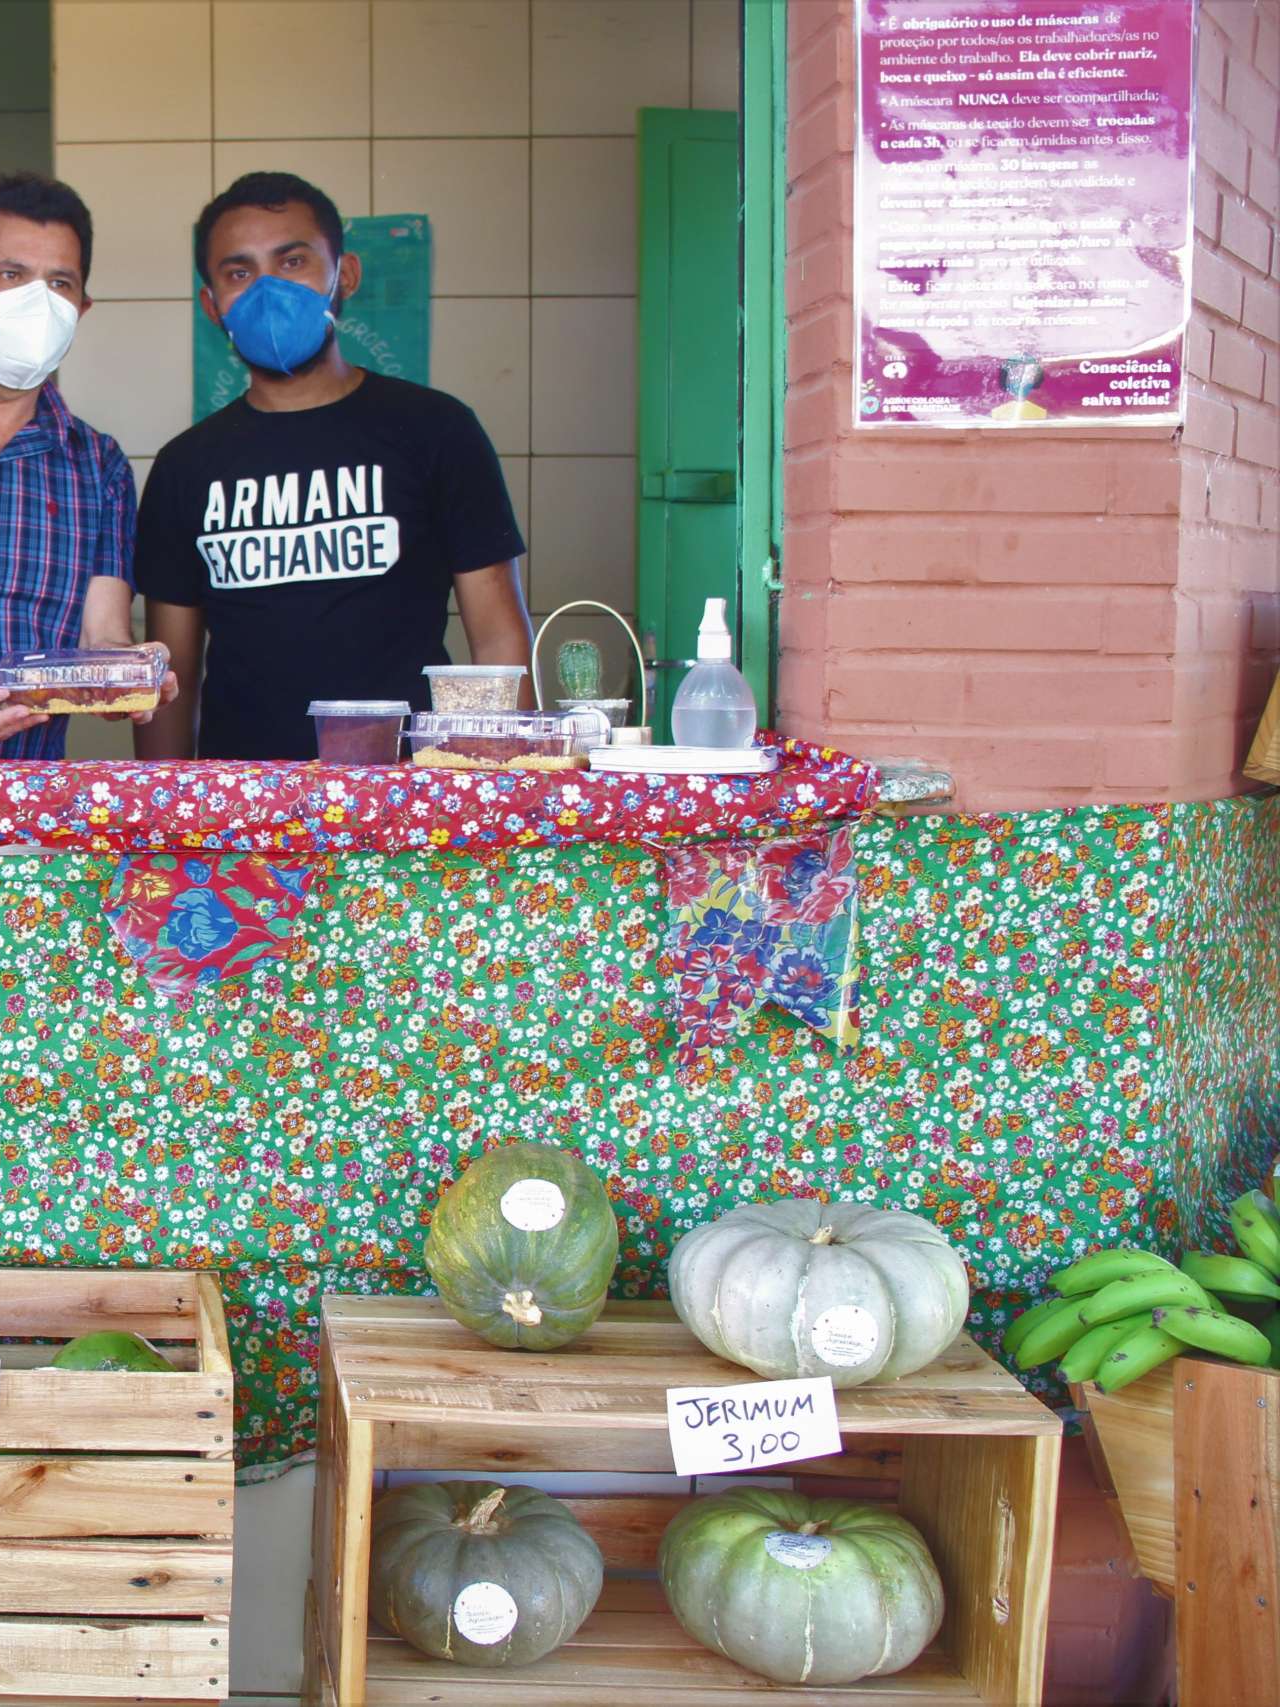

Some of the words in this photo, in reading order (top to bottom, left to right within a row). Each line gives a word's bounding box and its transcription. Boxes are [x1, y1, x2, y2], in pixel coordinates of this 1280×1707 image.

[888, 19, 897, 29] É
[902, 17, 977, 31] obrigatório
[979, 19, 988, 27] o
[991, 18, 1014, 27] uso
[1017, 15, 1032, 26] de
[1035, 14, 1098, 26] máscaras
[1105, 13, 1120, 24] de
[880, 35, 934, 50] proteção
[937, 38, 958, 49] por
[961, 33, 1014, 45] todos/as
[1017, 35, 1031, 44] os
[1035, 29, 1139, 43] trabalhadores/as
[1142, 32, 1159, 40] no
[880, 53, 937, 64] ambiente
[939, 52, 955, 63] do
[959, 51, 1013, 63] trabalho.
[1019, 50, 1039, 61] Ela
[1042, 50, 1071, 61] deve
[1074, 49, 1115, 60] cobrir
[1118, 48, 1157, 59] nariz,
[880, 71, 911, 82] boca
[913, 74, 920, 82] e
[923, 69, 966, 84] queixo
[978, 69, 992, 80] só
[995, 68, 1034, 80] assim
[1036, 67, 1055, 79] ela
[1058, 67, 1065, 79] é
[1068, 66, 1127, 78] eficiente.
[888, 95, 898, 106] A
[901, 94, 952, 106] máscara
[959, 93, 1008, 105] NUNCA
[1011, 92, 1040, 103] deve
[1043, 94, 1061, 103] ser
[1064, 89, 1160, 105] compartilhada;
[888, 119, 904, 131] As
[908, 118, 966, 130] máscaras
[969, 117, 984, 128] de
[987, 116, 1024, 128] tecido
[1027, 115, 1069, 127] devem
[1072, 117, 1090, 125] ser
[1096, 112, 1155, 125] trocadas
[880, 140, 888, 148] a
[890, 137, 922, 148] cada
[923, 136, 943, 147] 3h,
[947, 139, 961, 147] ou
[982, 134, 1028, 146] ficarem
[1032, 133, 1076, 145] úmidas
[1079, 135, 1113, 144] antes
[1116, 131, 1152, 143] disso.
[999, 158, 1019, 170] 30
[1021, 158, 1078, 172] lavagens
[1074, 174, 1125, 186] validade
[888, 280, 920, 292] Evite
[1079, 360, 1171, 375] Consciência
[1109, 376, 1171, 390] coletiva
[1081, 394, 1122, 407] salva
[1124, 391, 1170, 406] vidas!
[204, 464, 383, 532] ARMANI
[203, 523, 388, 584] EXCHANGE
[676, 1393, 815, 1429] JERIMUM
[722, 1431, 801, 1463] 3,00
